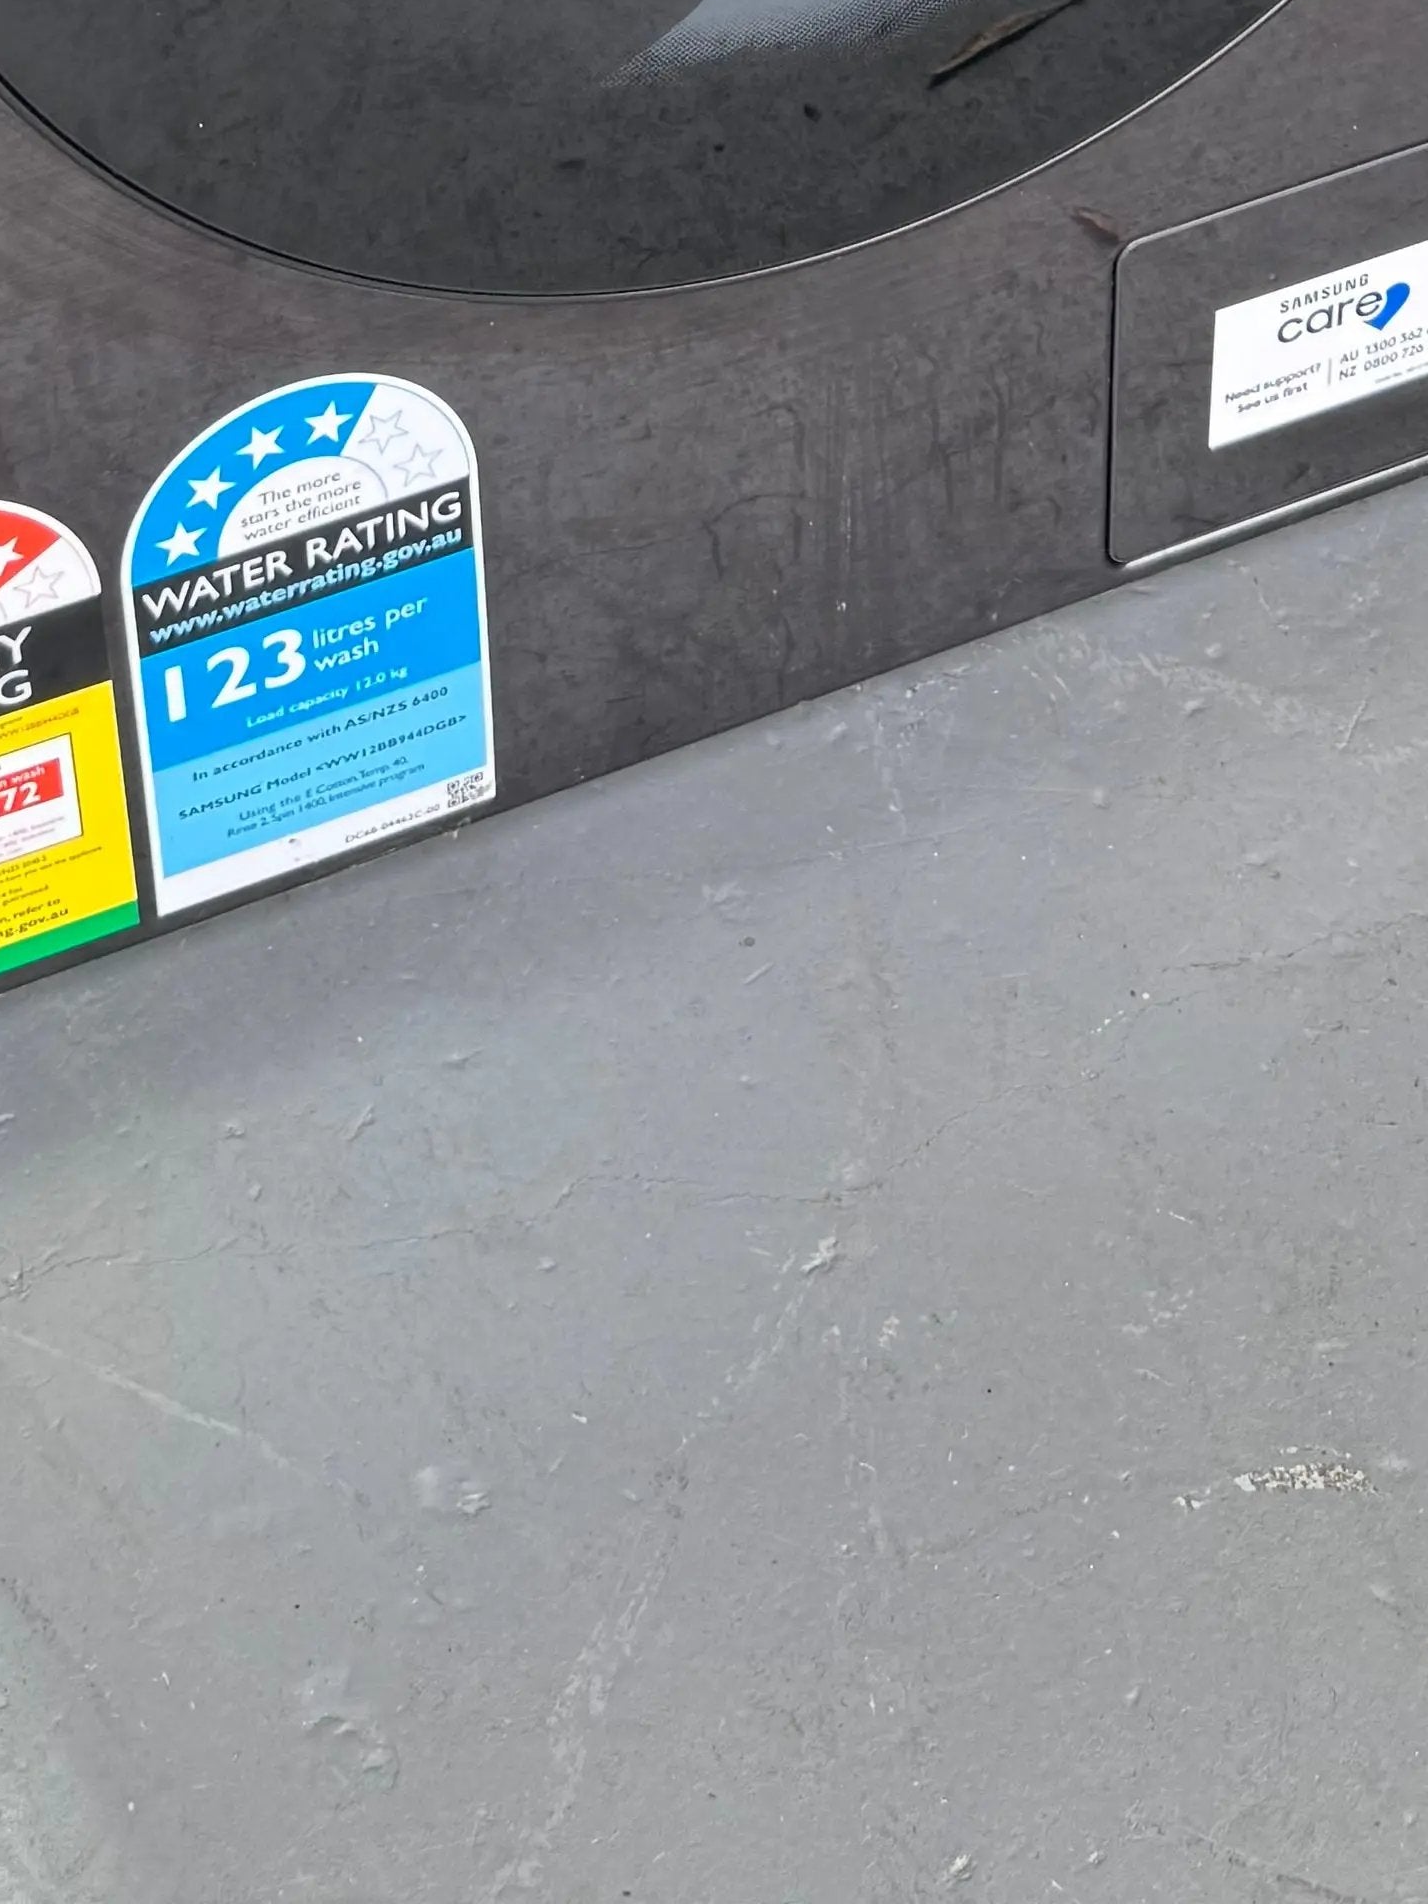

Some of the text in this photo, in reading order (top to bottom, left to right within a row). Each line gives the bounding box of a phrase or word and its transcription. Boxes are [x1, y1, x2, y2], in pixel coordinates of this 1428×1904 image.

[1279, 274, 1369, 314] SAMSUNG
[1277, 292, 1383, 343] care
[1339, 366, 1357, 380] NZ
[1364, 352, 1398, 370] 0800
[1340, 349, 1359, 363] AU
[1366, 337, 1396, 355] 1300
[1225, 362, 1321, 403] Need support?
[1264, 393, 1279, 404] us
[1283, 382, 1308, 398] first
[240, 479, 361, 528] stars the more
[257, 471, 341, 506] The more
[243, 494, 361, 541] water efficient
[142, 491, 461, 621] WATER RATING
[149, 528, 461, 644] www.waterrating.gov.au
[313, 597, 427, 648] litres per
[165, 629, 305, 722] 123
[314, 637, 379, 671] wash
[246, 665, 408, 728] Load capacity 12.0 kg
[192, 686, 449, 782] In accordance with AS/NZS 6400
[11, 764, 45, 784] wash
[179, 783, 261, 821] SAMSUNG
[266, 768, 312, 790] Model
[239, 802, 277, 823] Using
[279, 794, 302, 809] the
[12, 902, 44, 920] refer
[46, 896, 60, 908] to
